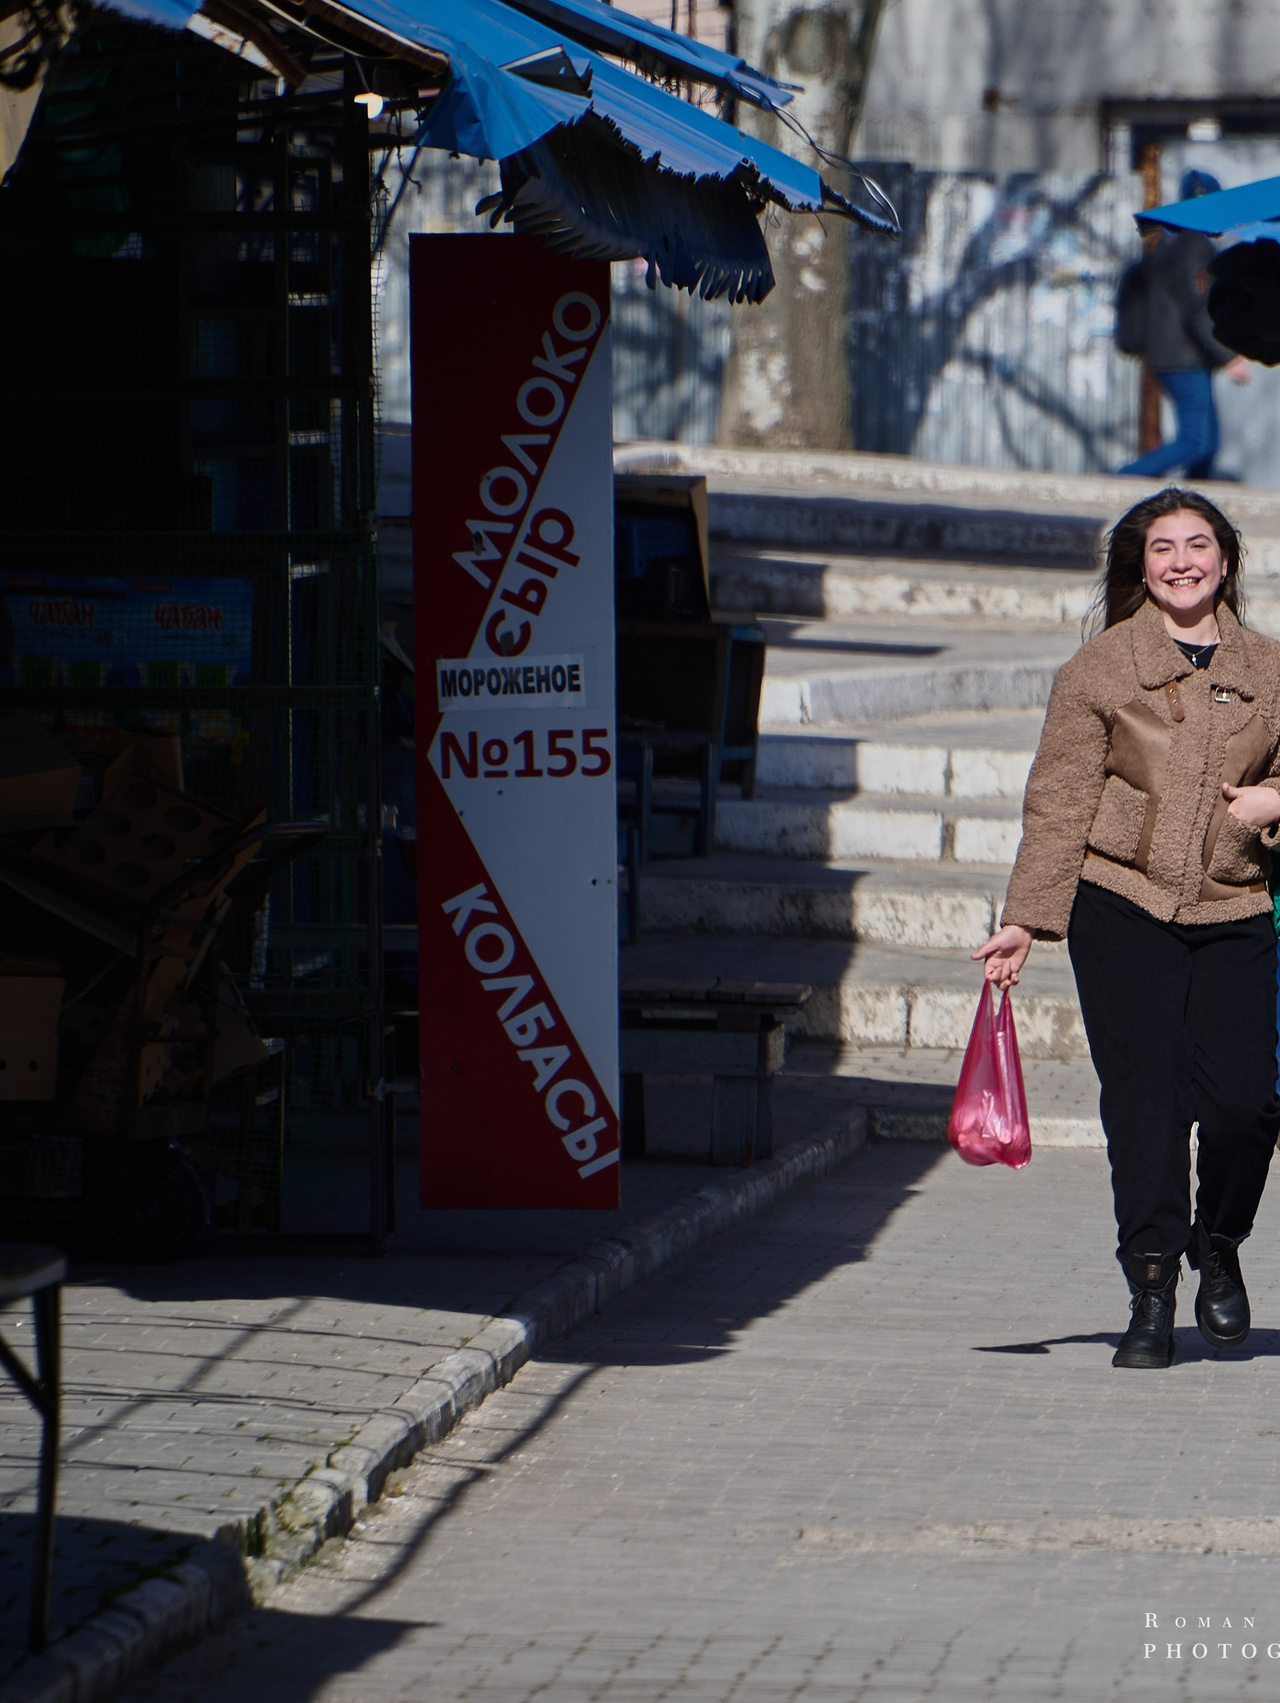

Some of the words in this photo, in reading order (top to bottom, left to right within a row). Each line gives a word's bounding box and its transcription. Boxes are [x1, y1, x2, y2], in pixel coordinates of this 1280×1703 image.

[451, 291, 602, 589] МОЛОКО
[439, 728, 612, 780] №155
[440, 664, 582, 698] МОРОЖЕНОЕ
[441, 882, 619, 1179] КОЛБАСЫ
